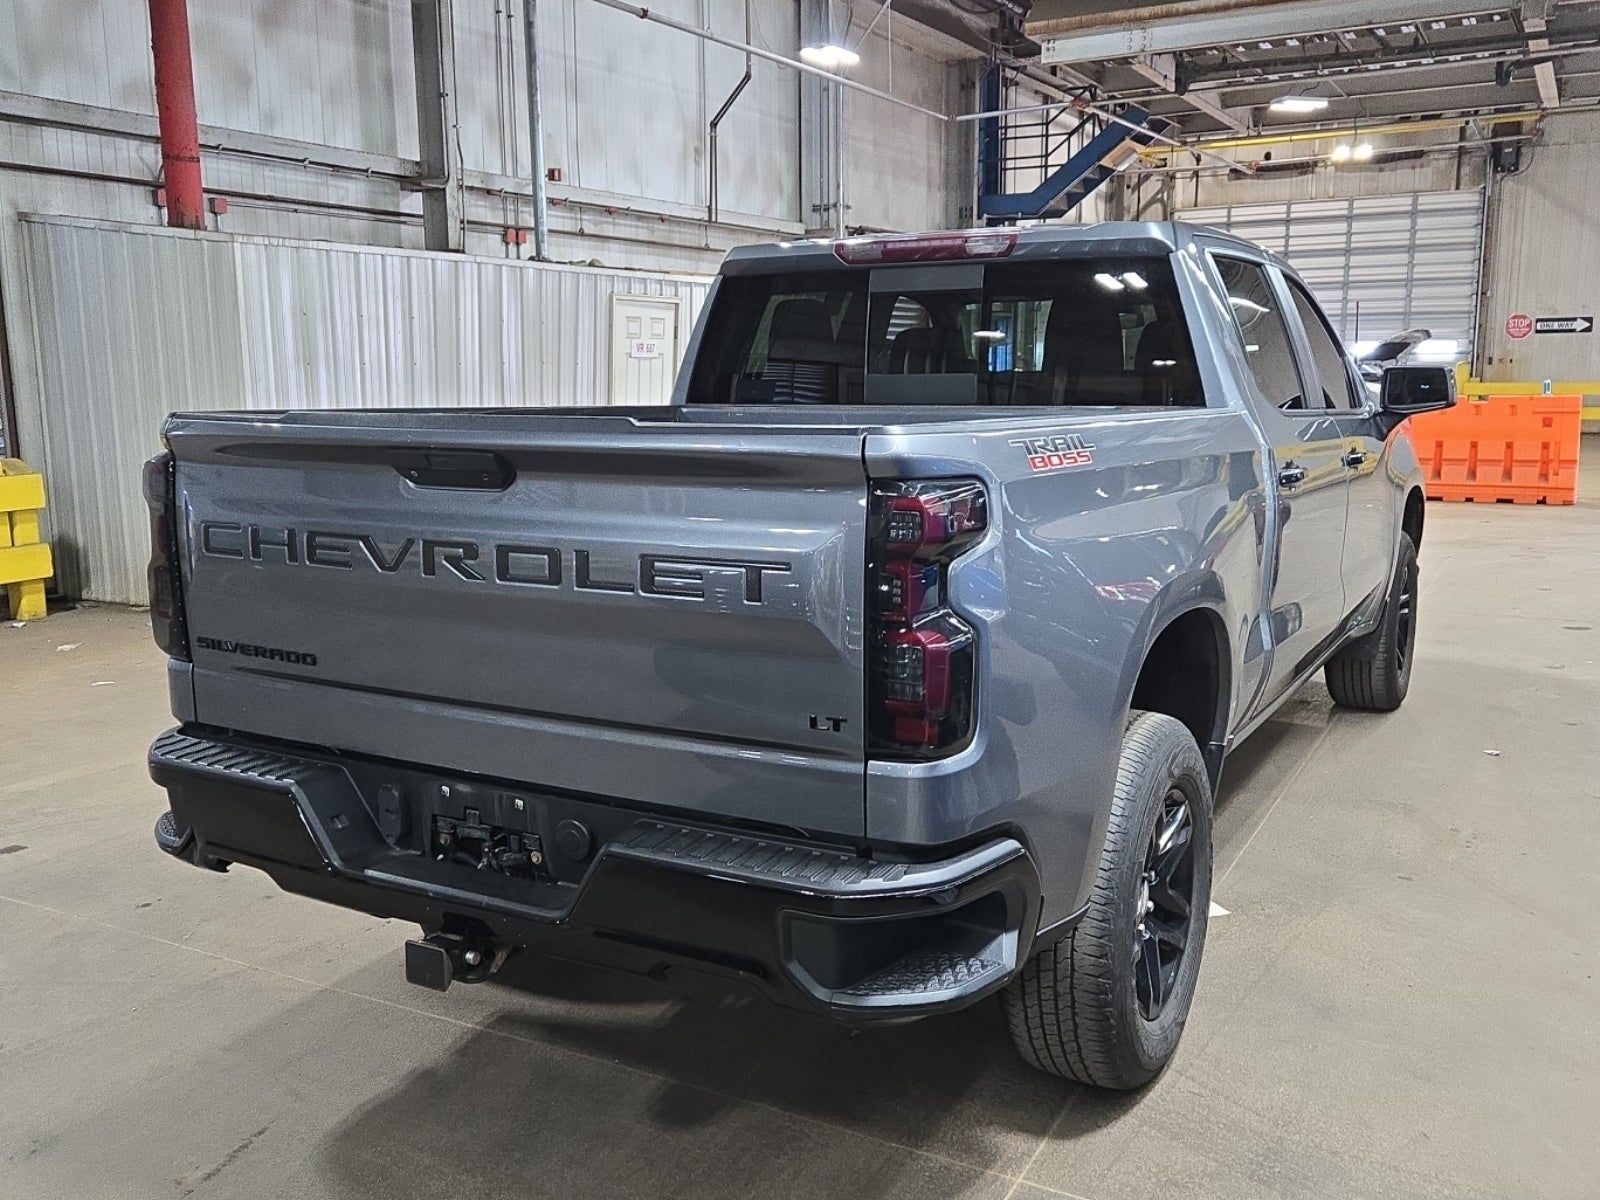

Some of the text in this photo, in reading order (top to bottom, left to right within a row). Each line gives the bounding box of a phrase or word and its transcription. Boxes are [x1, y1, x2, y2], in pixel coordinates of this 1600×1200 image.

[1508, 319, 1531, 328] STOP
[1558, 321, 1575, 329] WAY
[1008, 434, 1096, 455] TRAIL
[1028, 451, 1092, 471] BOSS
[200, 521, 792, 606] CHEVROLET
[196, 636, 317, 666] SILVERADO
[808, 714, 848, 732] LT
